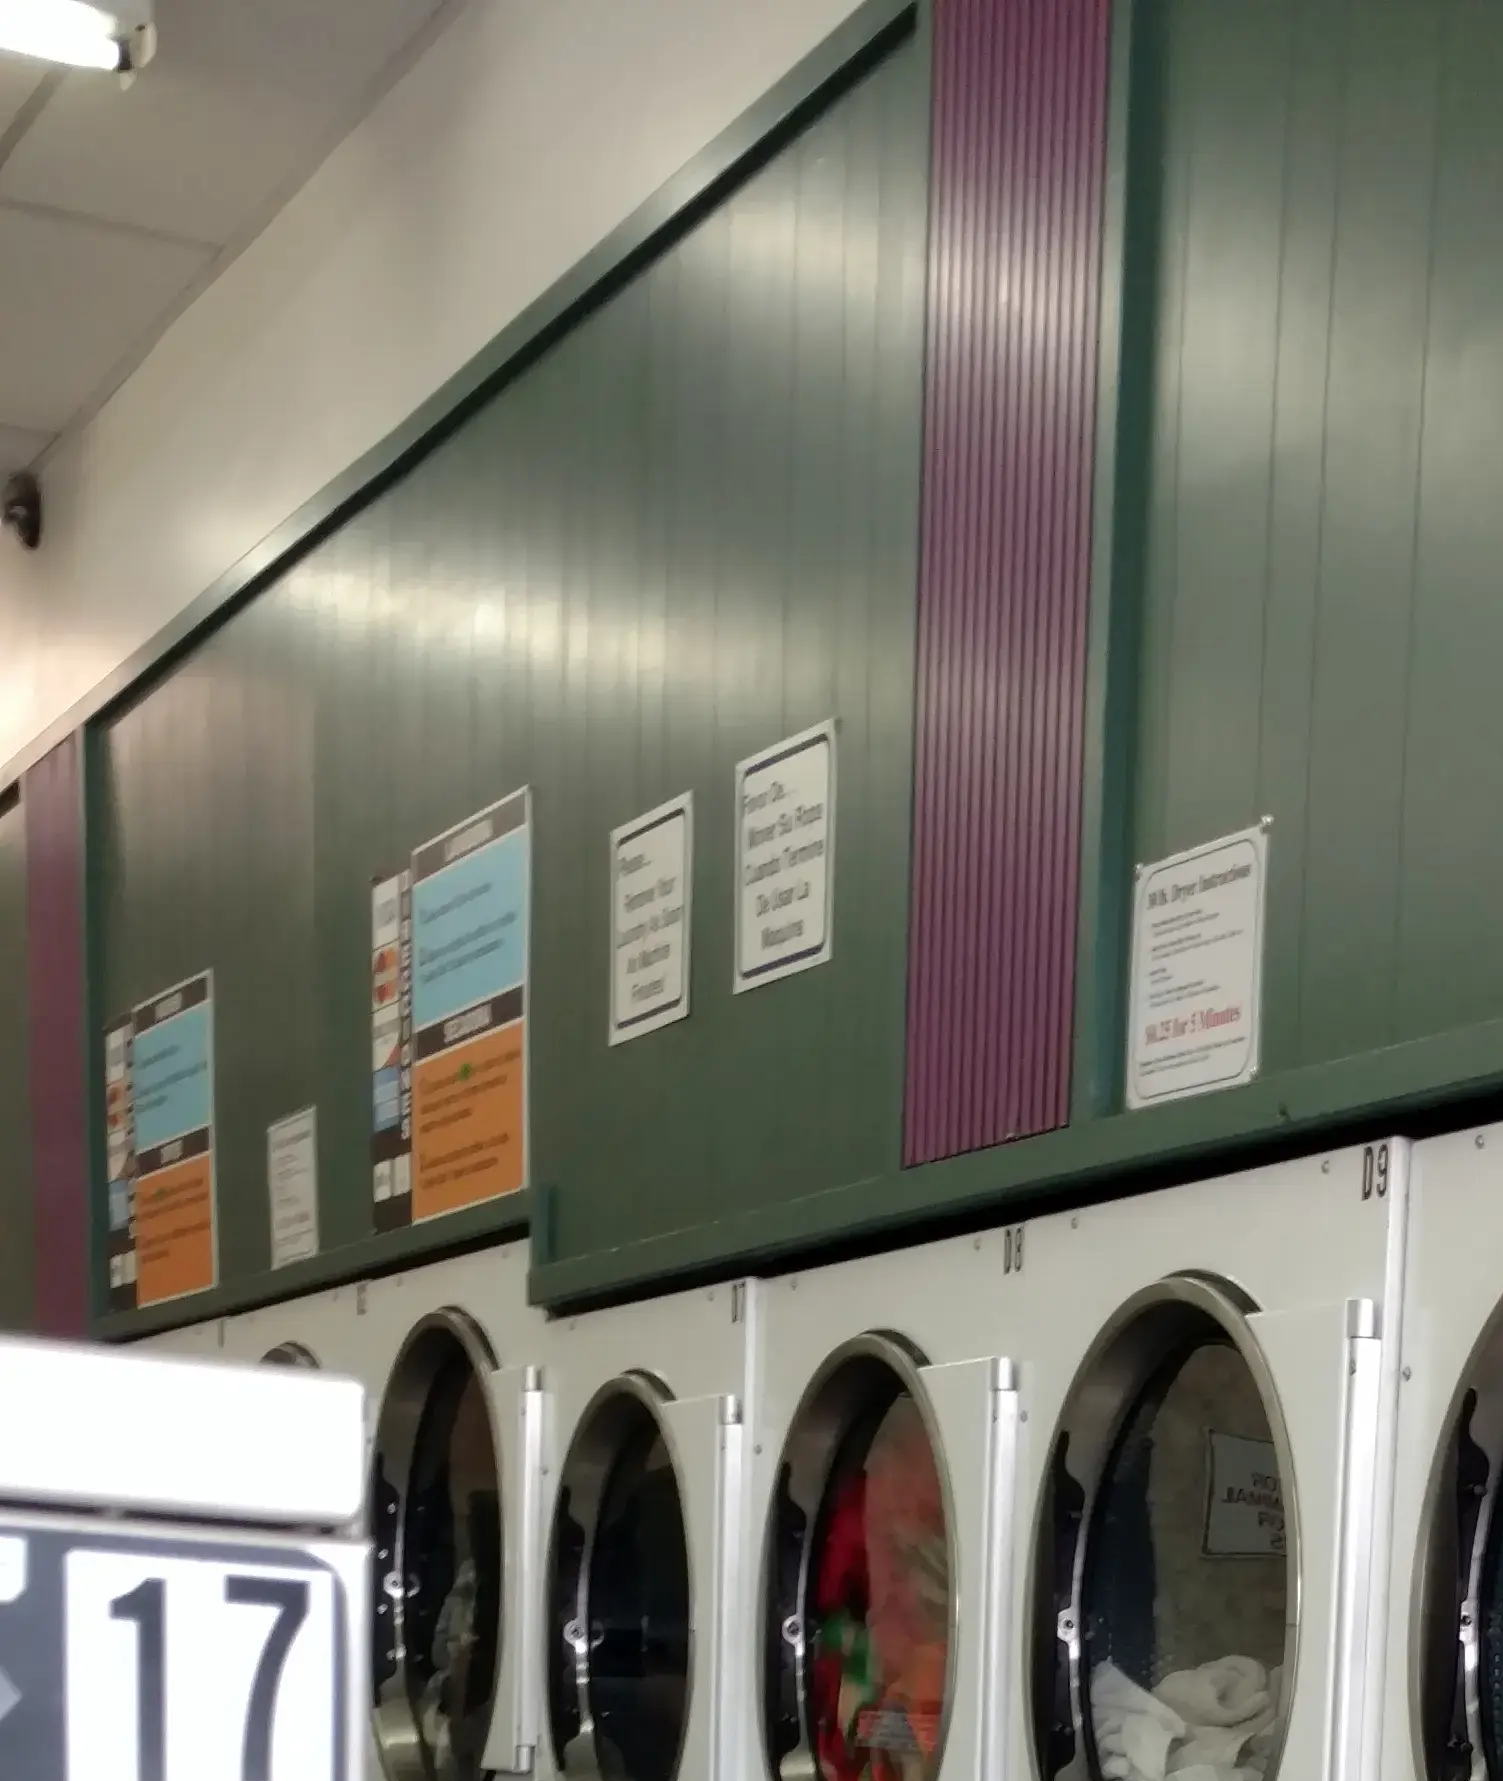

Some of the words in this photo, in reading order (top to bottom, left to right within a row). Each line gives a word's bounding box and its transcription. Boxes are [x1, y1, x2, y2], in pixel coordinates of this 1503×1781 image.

[1199, 1006, 1242, 1031] Minutes
[1361, 1143, 1389, 1202] D9
[1003, 1227, 1024, 1275] D8
